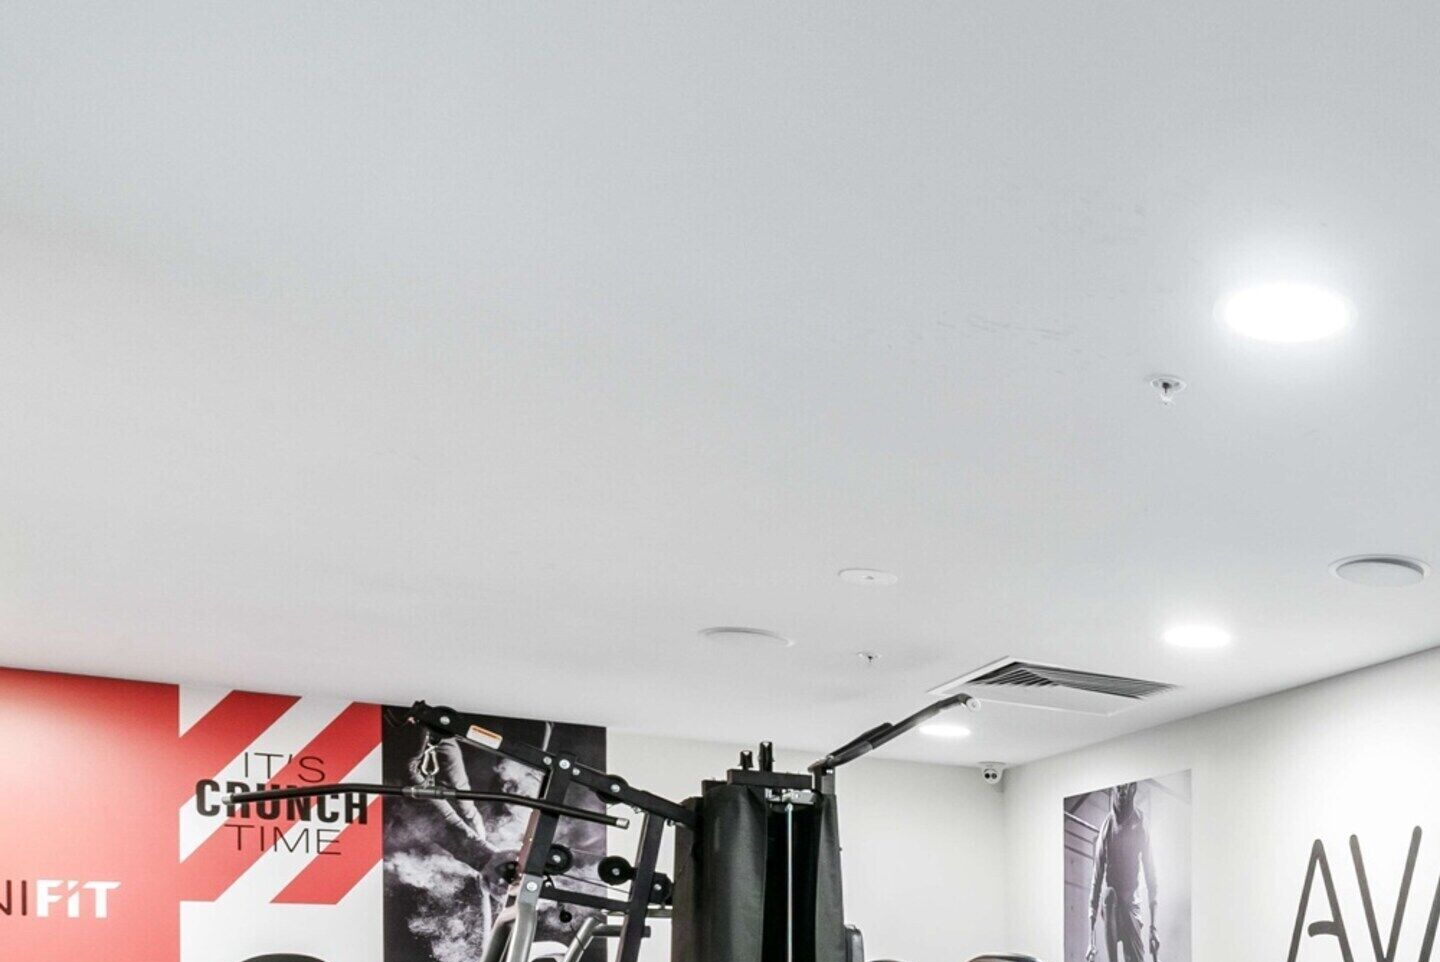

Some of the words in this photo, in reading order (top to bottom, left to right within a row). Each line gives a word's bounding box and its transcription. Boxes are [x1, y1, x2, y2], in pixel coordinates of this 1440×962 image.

[244, 752, 326, 784] IT'S
[195, 778, 368, 826] CRUNCH
[224, 823, 342, 856] TIME
